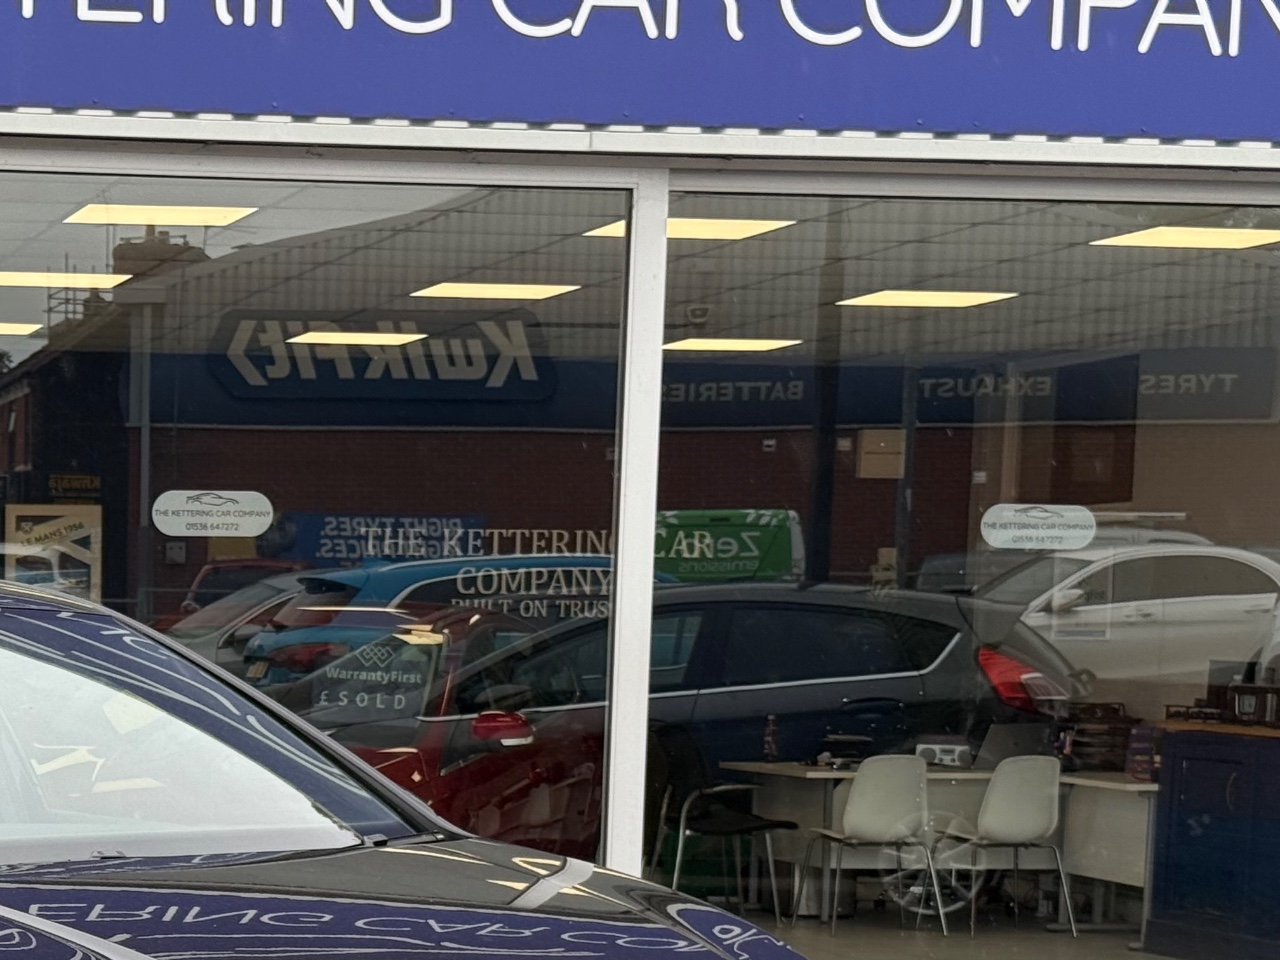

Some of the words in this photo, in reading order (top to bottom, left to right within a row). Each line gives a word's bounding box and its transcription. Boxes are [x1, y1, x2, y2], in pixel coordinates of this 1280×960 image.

[154, 509, 170, 518] THE
[171, 509, 214, 518] KETTERING
[215, 509, 232, 518] CAR
[233, 509, 271, 518] COMPANY
[34, 527, 64, 543] MANS
[64, 521, 86, 534] 1956
[185, 522, 208, 531] 01536
[209, 522, 240, 531] 647272
[360, 527, 427, 556] THE
[442, 527, 614, 557] KETTERIN
[456, 566, 614, 597] COMPANY
[519, 599, 548, 619] ON
[556, 599, 610, 619] TRUS
[325, 666, 423, 685] WarrantyFirst
